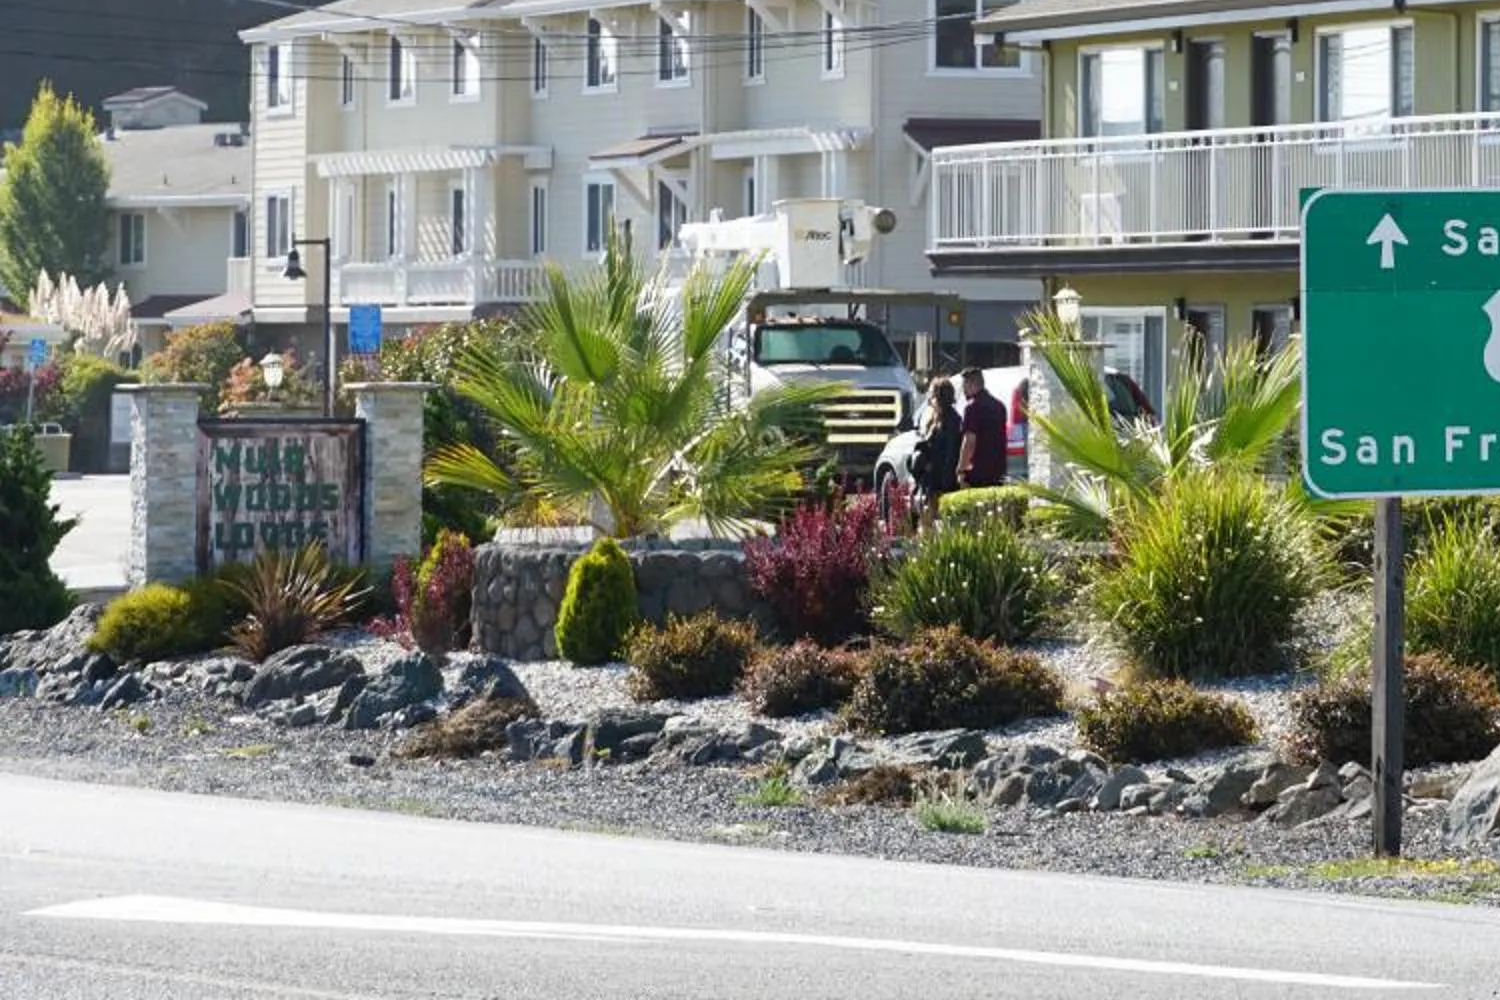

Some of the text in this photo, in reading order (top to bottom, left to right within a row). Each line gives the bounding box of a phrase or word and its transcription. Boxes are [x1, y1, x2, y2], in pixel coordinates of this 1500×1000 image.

[1321, 428, 1416, 465] San
[214, 483, 339, 511] WOODS
[215, 521, 329, 550] LODGE
